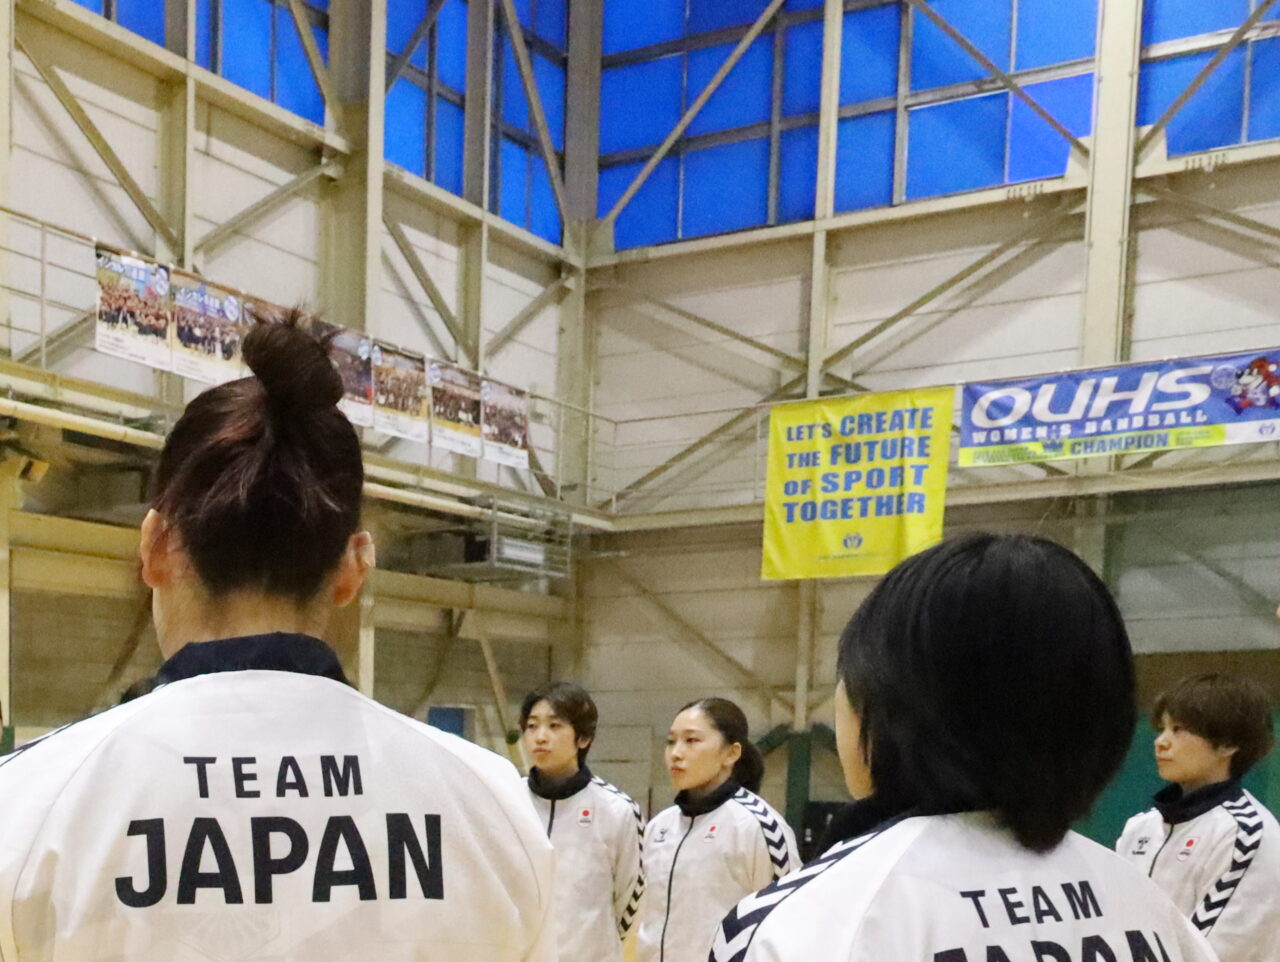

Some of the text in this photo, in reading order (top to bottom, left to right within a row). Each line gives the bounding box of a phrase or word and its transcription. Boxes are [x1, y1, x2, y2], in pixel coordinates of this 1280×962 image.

[971, 366, 1213, 428] OUHS
[786, 407, 934, 442] LET'S CREATE
[972, 410, 1208, 444] WOMEN'S HANDBALL
[786, 436, 932, 469] THE FUTURE
[1071, 432, 1169, 456] CHAMPION
[783, 464, 929, 497] OF SPORT
[782, 492, 927, 524] TOGETHER
[183, 755, 363, 798] TEAM
[115, 813, 444, 907] JAPAN
[959, 880, 1103, 928] TEAM
